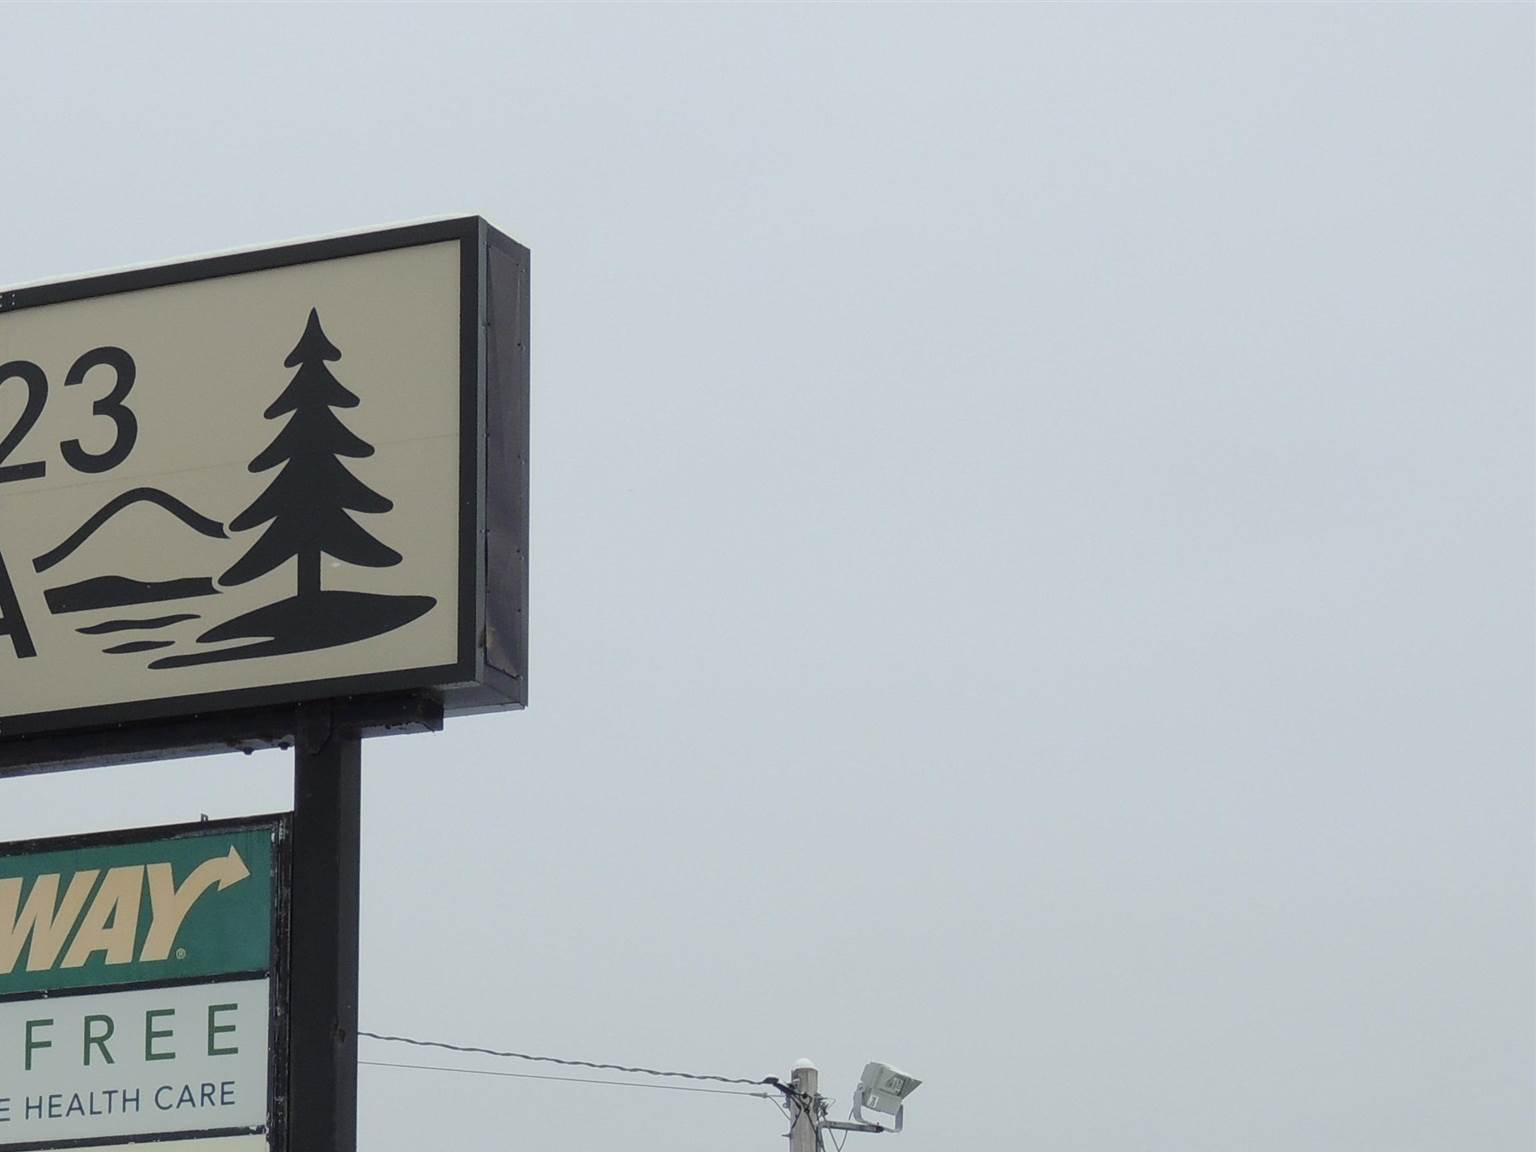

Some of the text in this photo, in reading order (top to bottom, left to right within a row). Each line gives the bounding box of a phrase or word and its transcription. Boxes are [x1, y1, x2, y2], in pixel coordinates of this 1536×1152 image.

[25, 1003, 239, 1071] FREE
[25, 1088, 140, 1121] HEALTH
[154, 1081, 236, 1110] CARE
